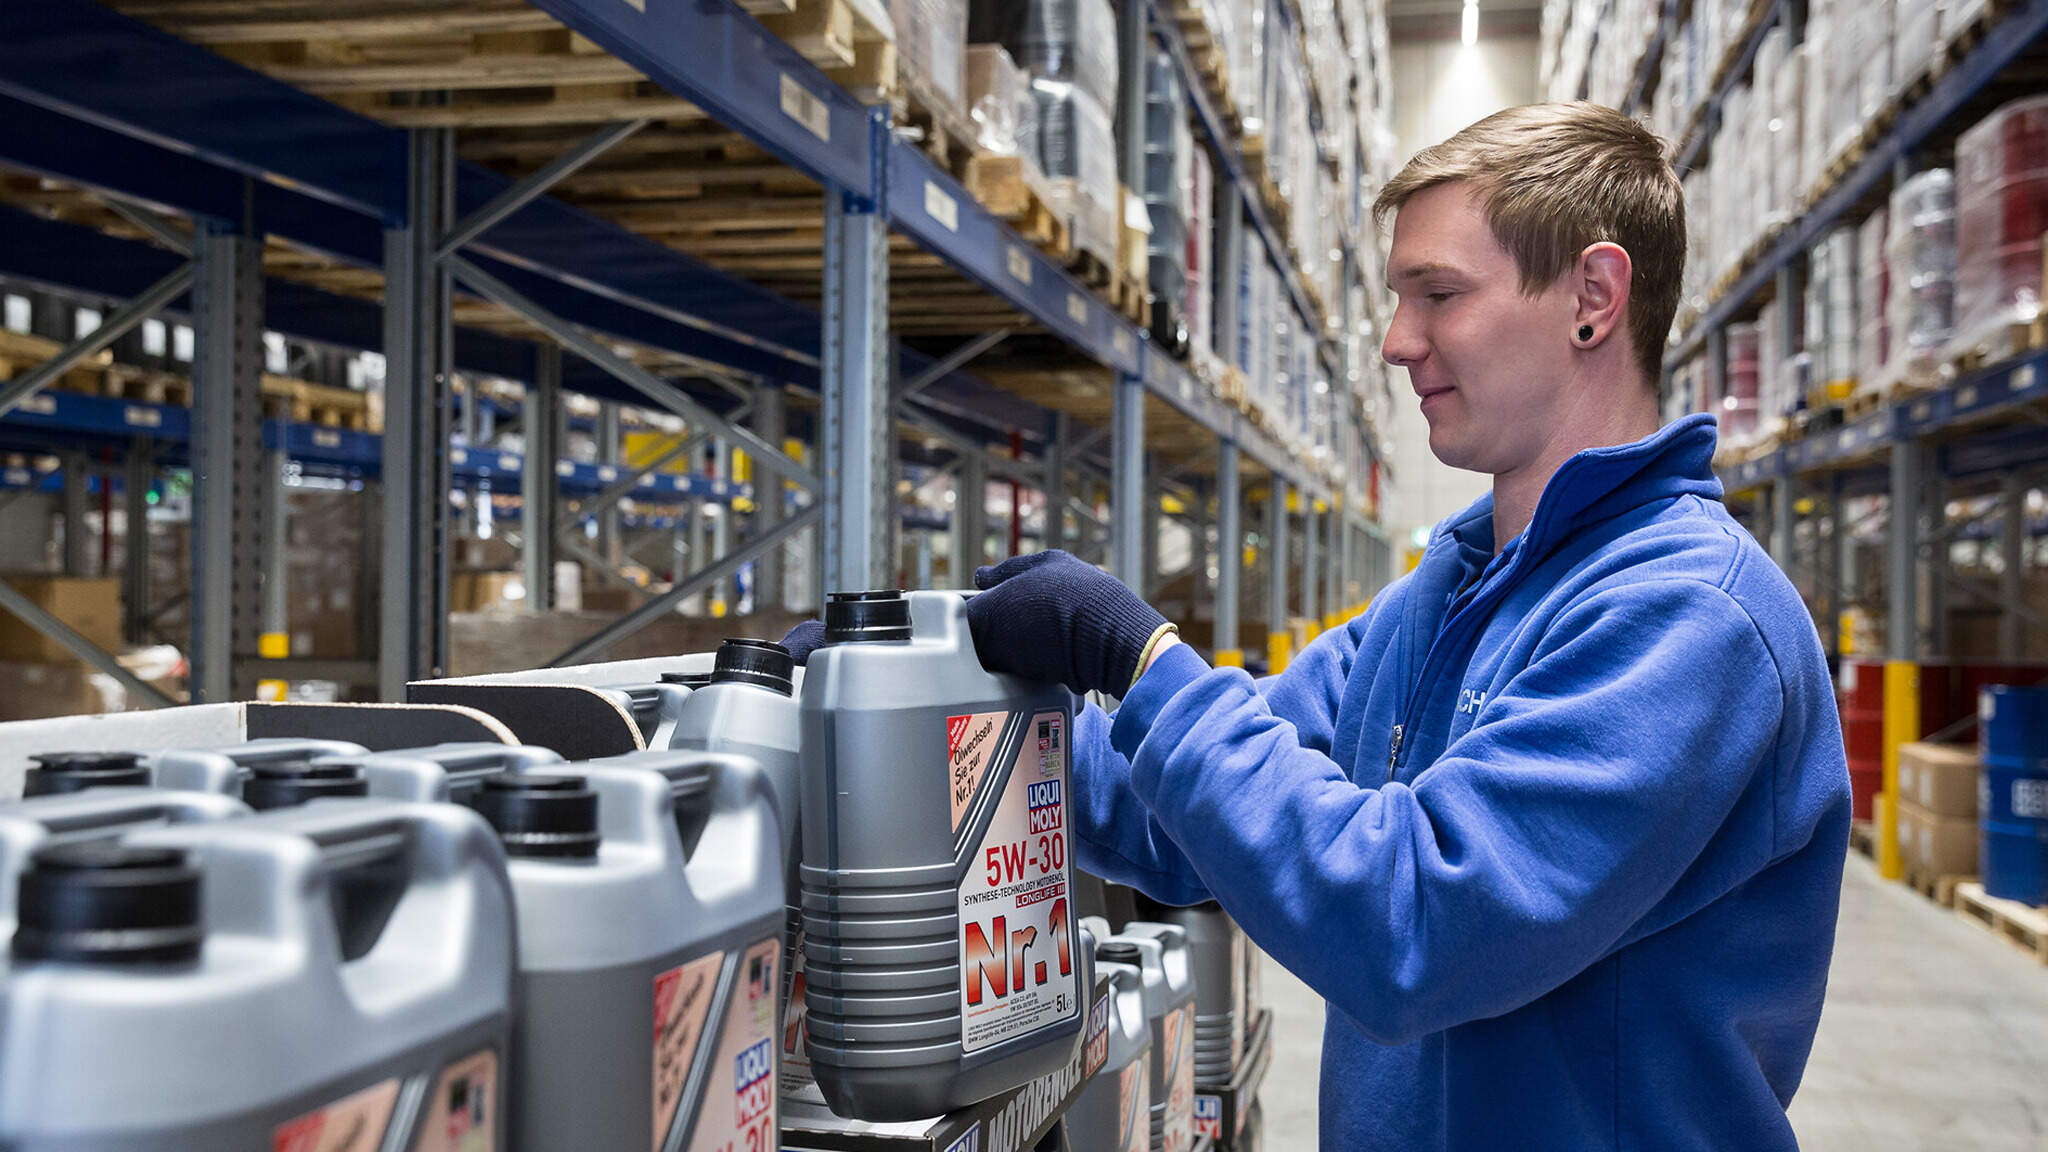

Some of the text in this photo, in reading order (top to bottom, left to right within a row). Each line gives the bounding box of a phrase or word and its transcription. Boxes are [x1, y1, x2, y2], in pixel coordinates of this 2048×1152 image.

[955, 752, 981, 786] Sie zur
[956, 775, 975, 807] Nr.1!
[1029, 781, 1060, 808] LIQUI
[1030, 806, 1060, 833] MOLY
[986, 832, 1065, 887] 5W-30
[964, 881, 1036, 906] SYNTHESE-TECHNOLOGY
[1016, 886, 1056, 907] LONGLIFE
[965, 897, 1072, 1007] Nr.1
